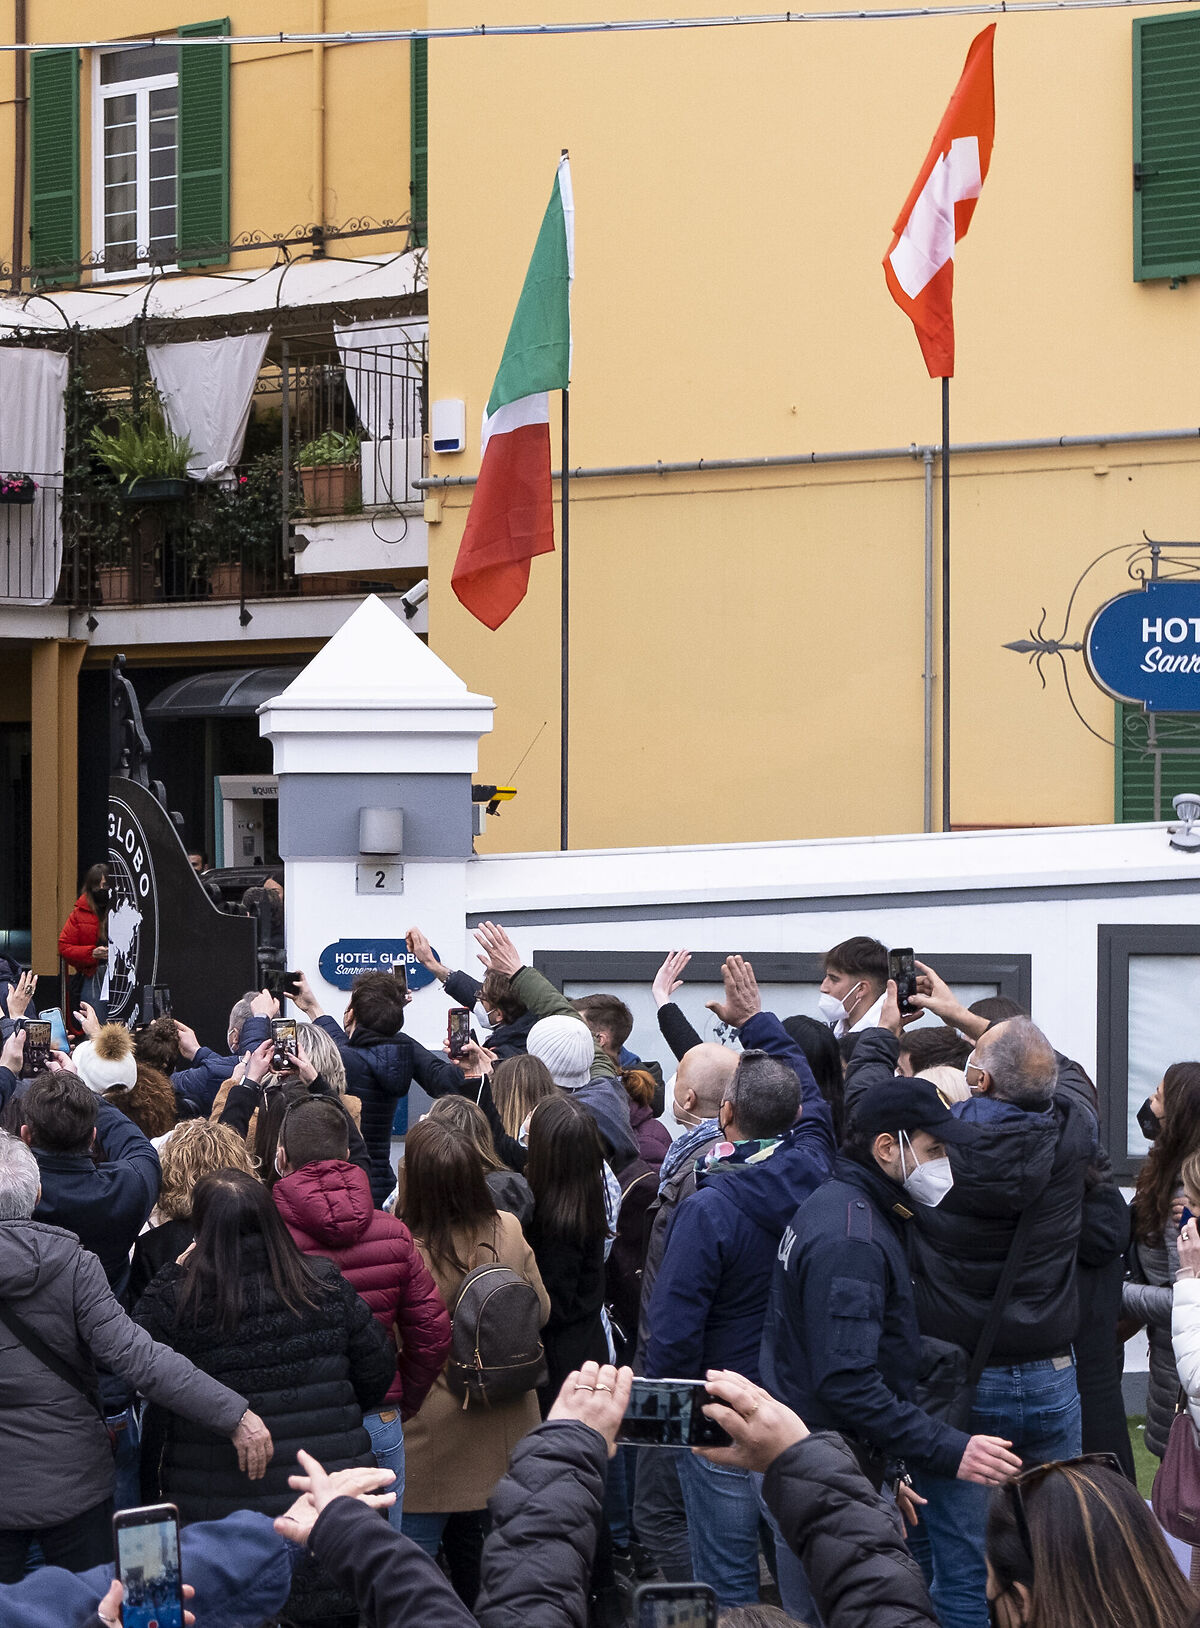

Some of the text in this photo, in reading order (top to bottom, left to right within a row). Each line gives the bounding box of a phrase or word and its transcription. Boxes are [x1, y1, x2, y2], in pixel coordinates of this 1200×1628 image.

[1142, 617, 1200, 643] HOT
[375, 870, 386, 888] 2
[335, 952, 377, 964] HOTEL
